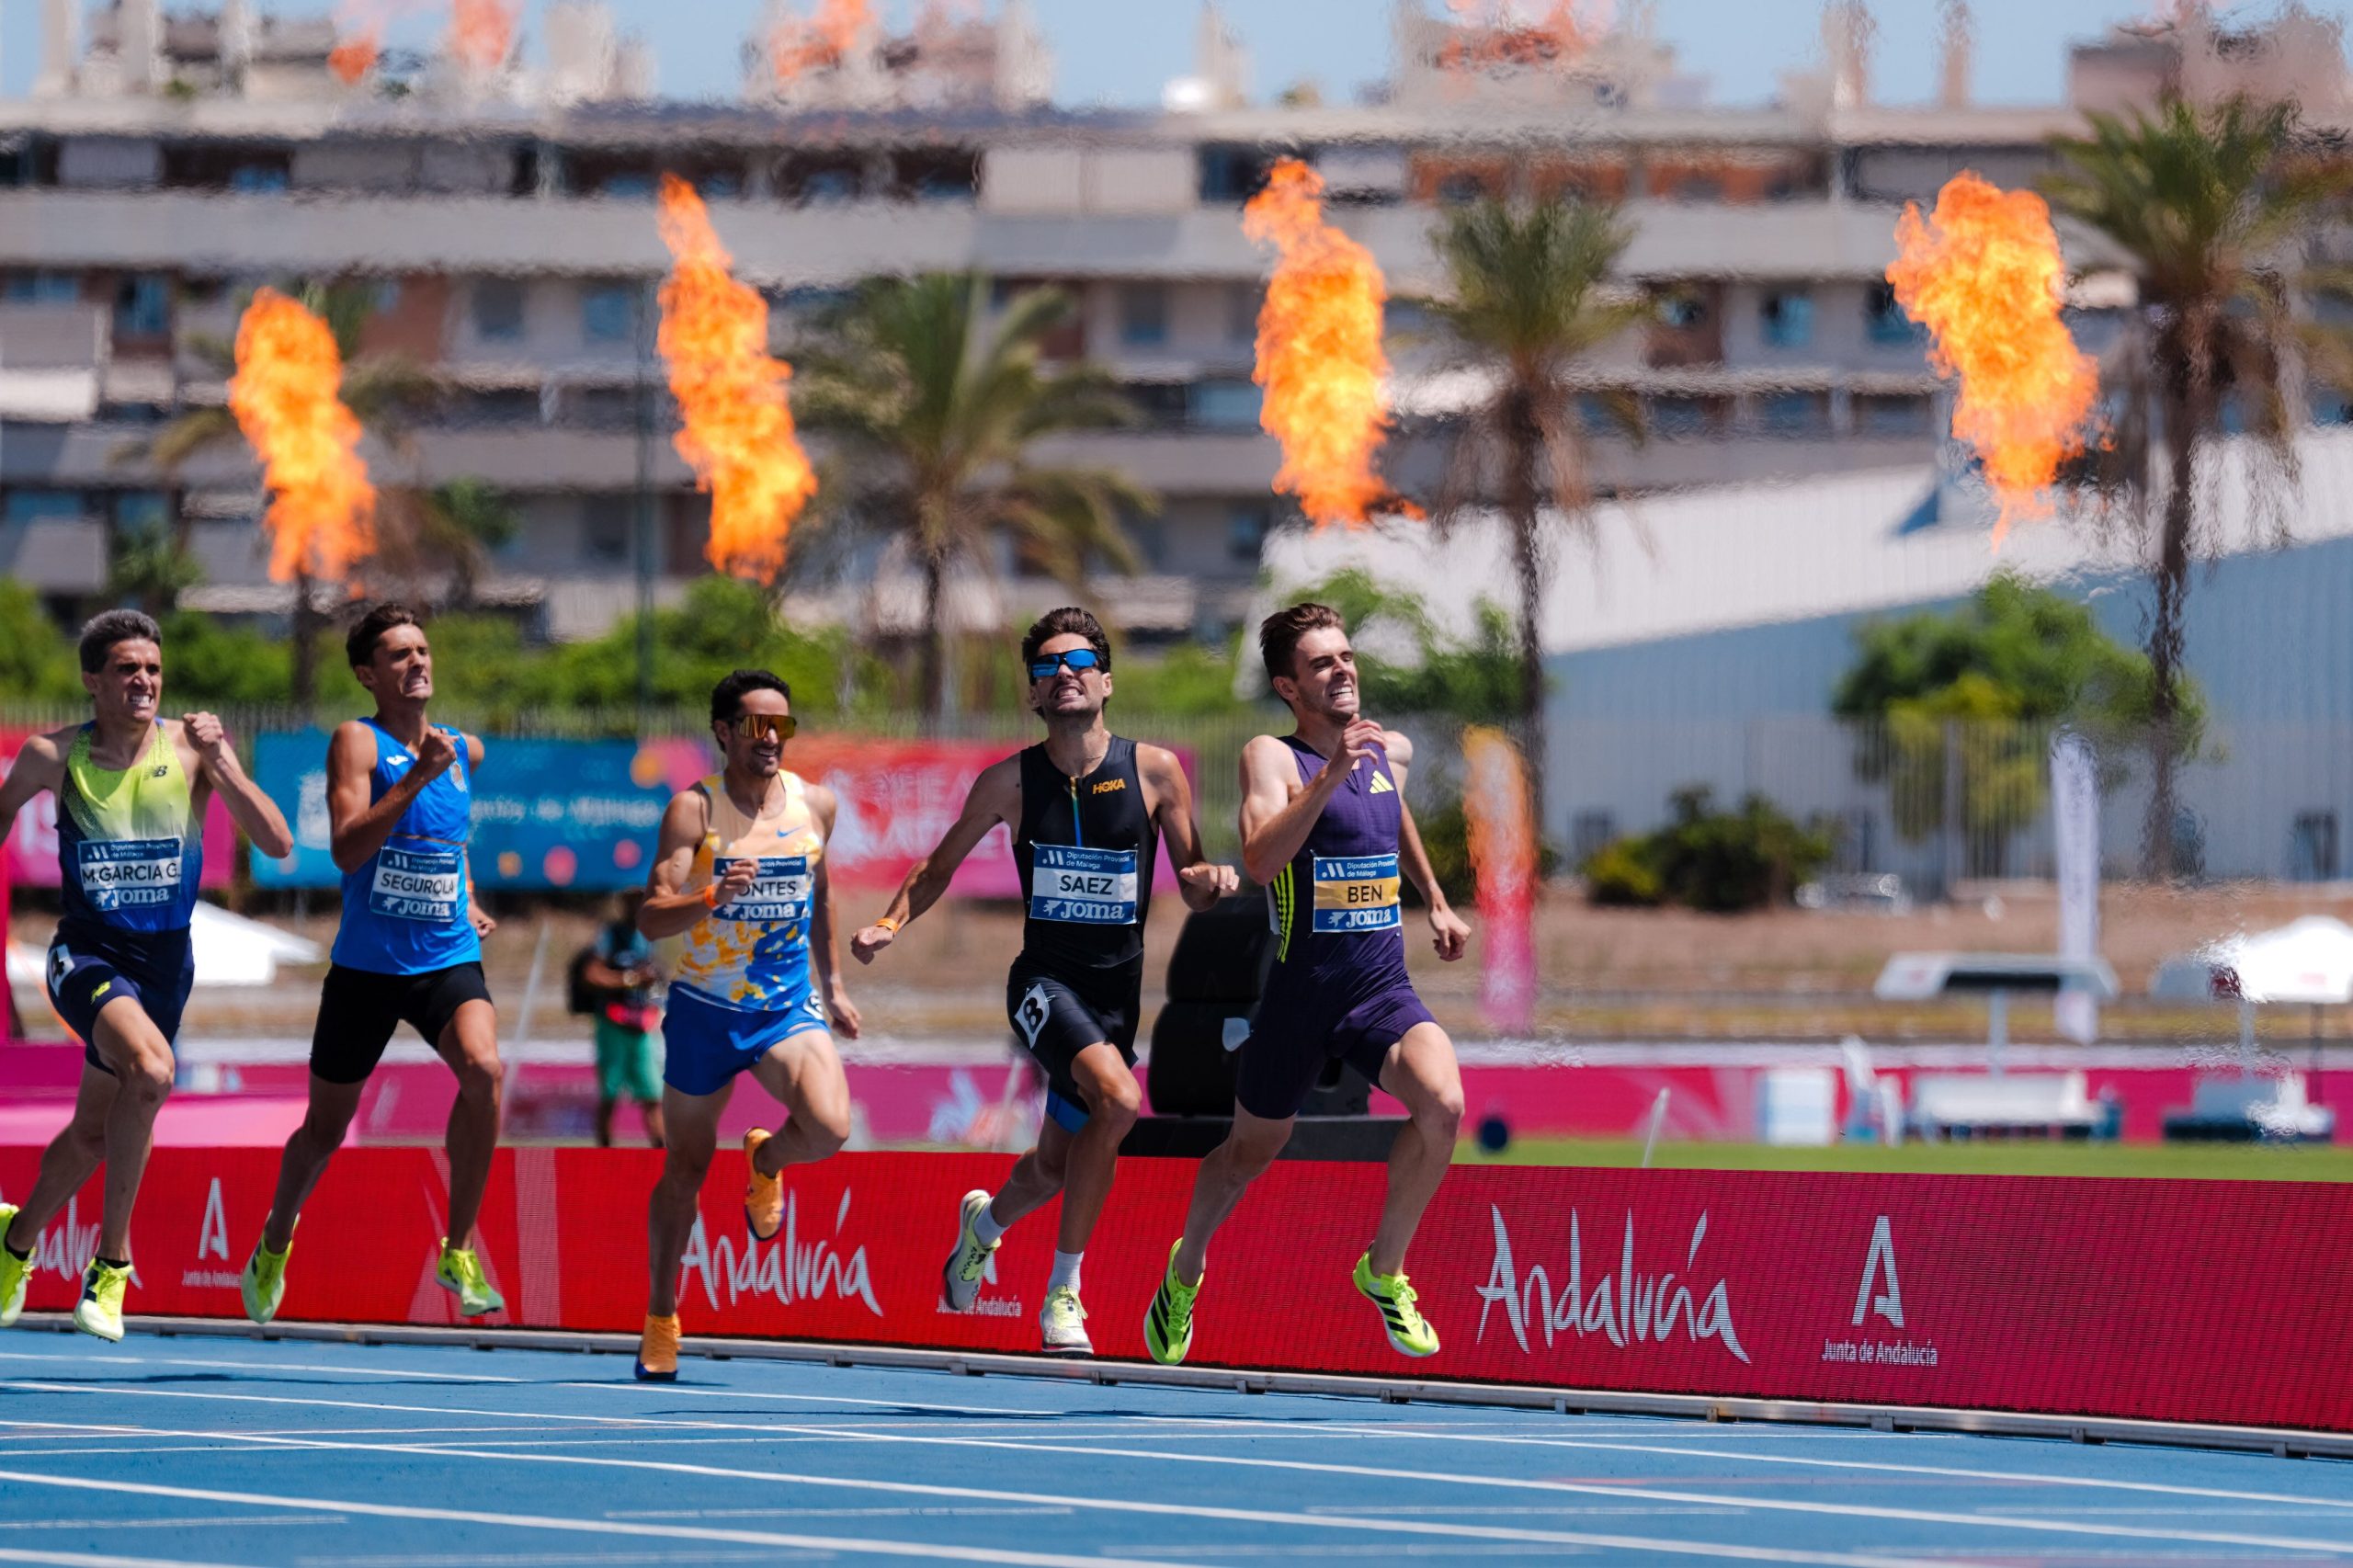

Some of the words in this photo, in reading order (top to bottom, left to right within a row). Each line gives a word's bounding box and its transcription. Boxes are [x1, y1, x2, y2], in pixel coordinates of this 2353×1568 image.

[1092, 778, 1126, 794] HOKA
[1066, 851, 1102, 861] Diputación
[1075, 860, 1101, 870] Málaga
[82, 865, 164, 883] M.GARCIA
[1347, 861, 1377, 870] Diputación
[1356, 869, 1377, 879] Málaga
[381, 872, 454, 894] SEGUROLA
[738, 881, 797, 897] ONTES
[1059, 874, 1114, 896] SAEZ
[1347, 885, 1382, 903] BEN
[1023, 997, 1044, 1034] 8
[676, 1185, 883, 1317] Andalucía
[1474, 1202, 1751, 1364] Andalucía
[1821, 1338, 1857, 1362] Junta
[1859, 1338, 1874, 1363] de
[1875, 1338, 1938, 1367] Andalucía
